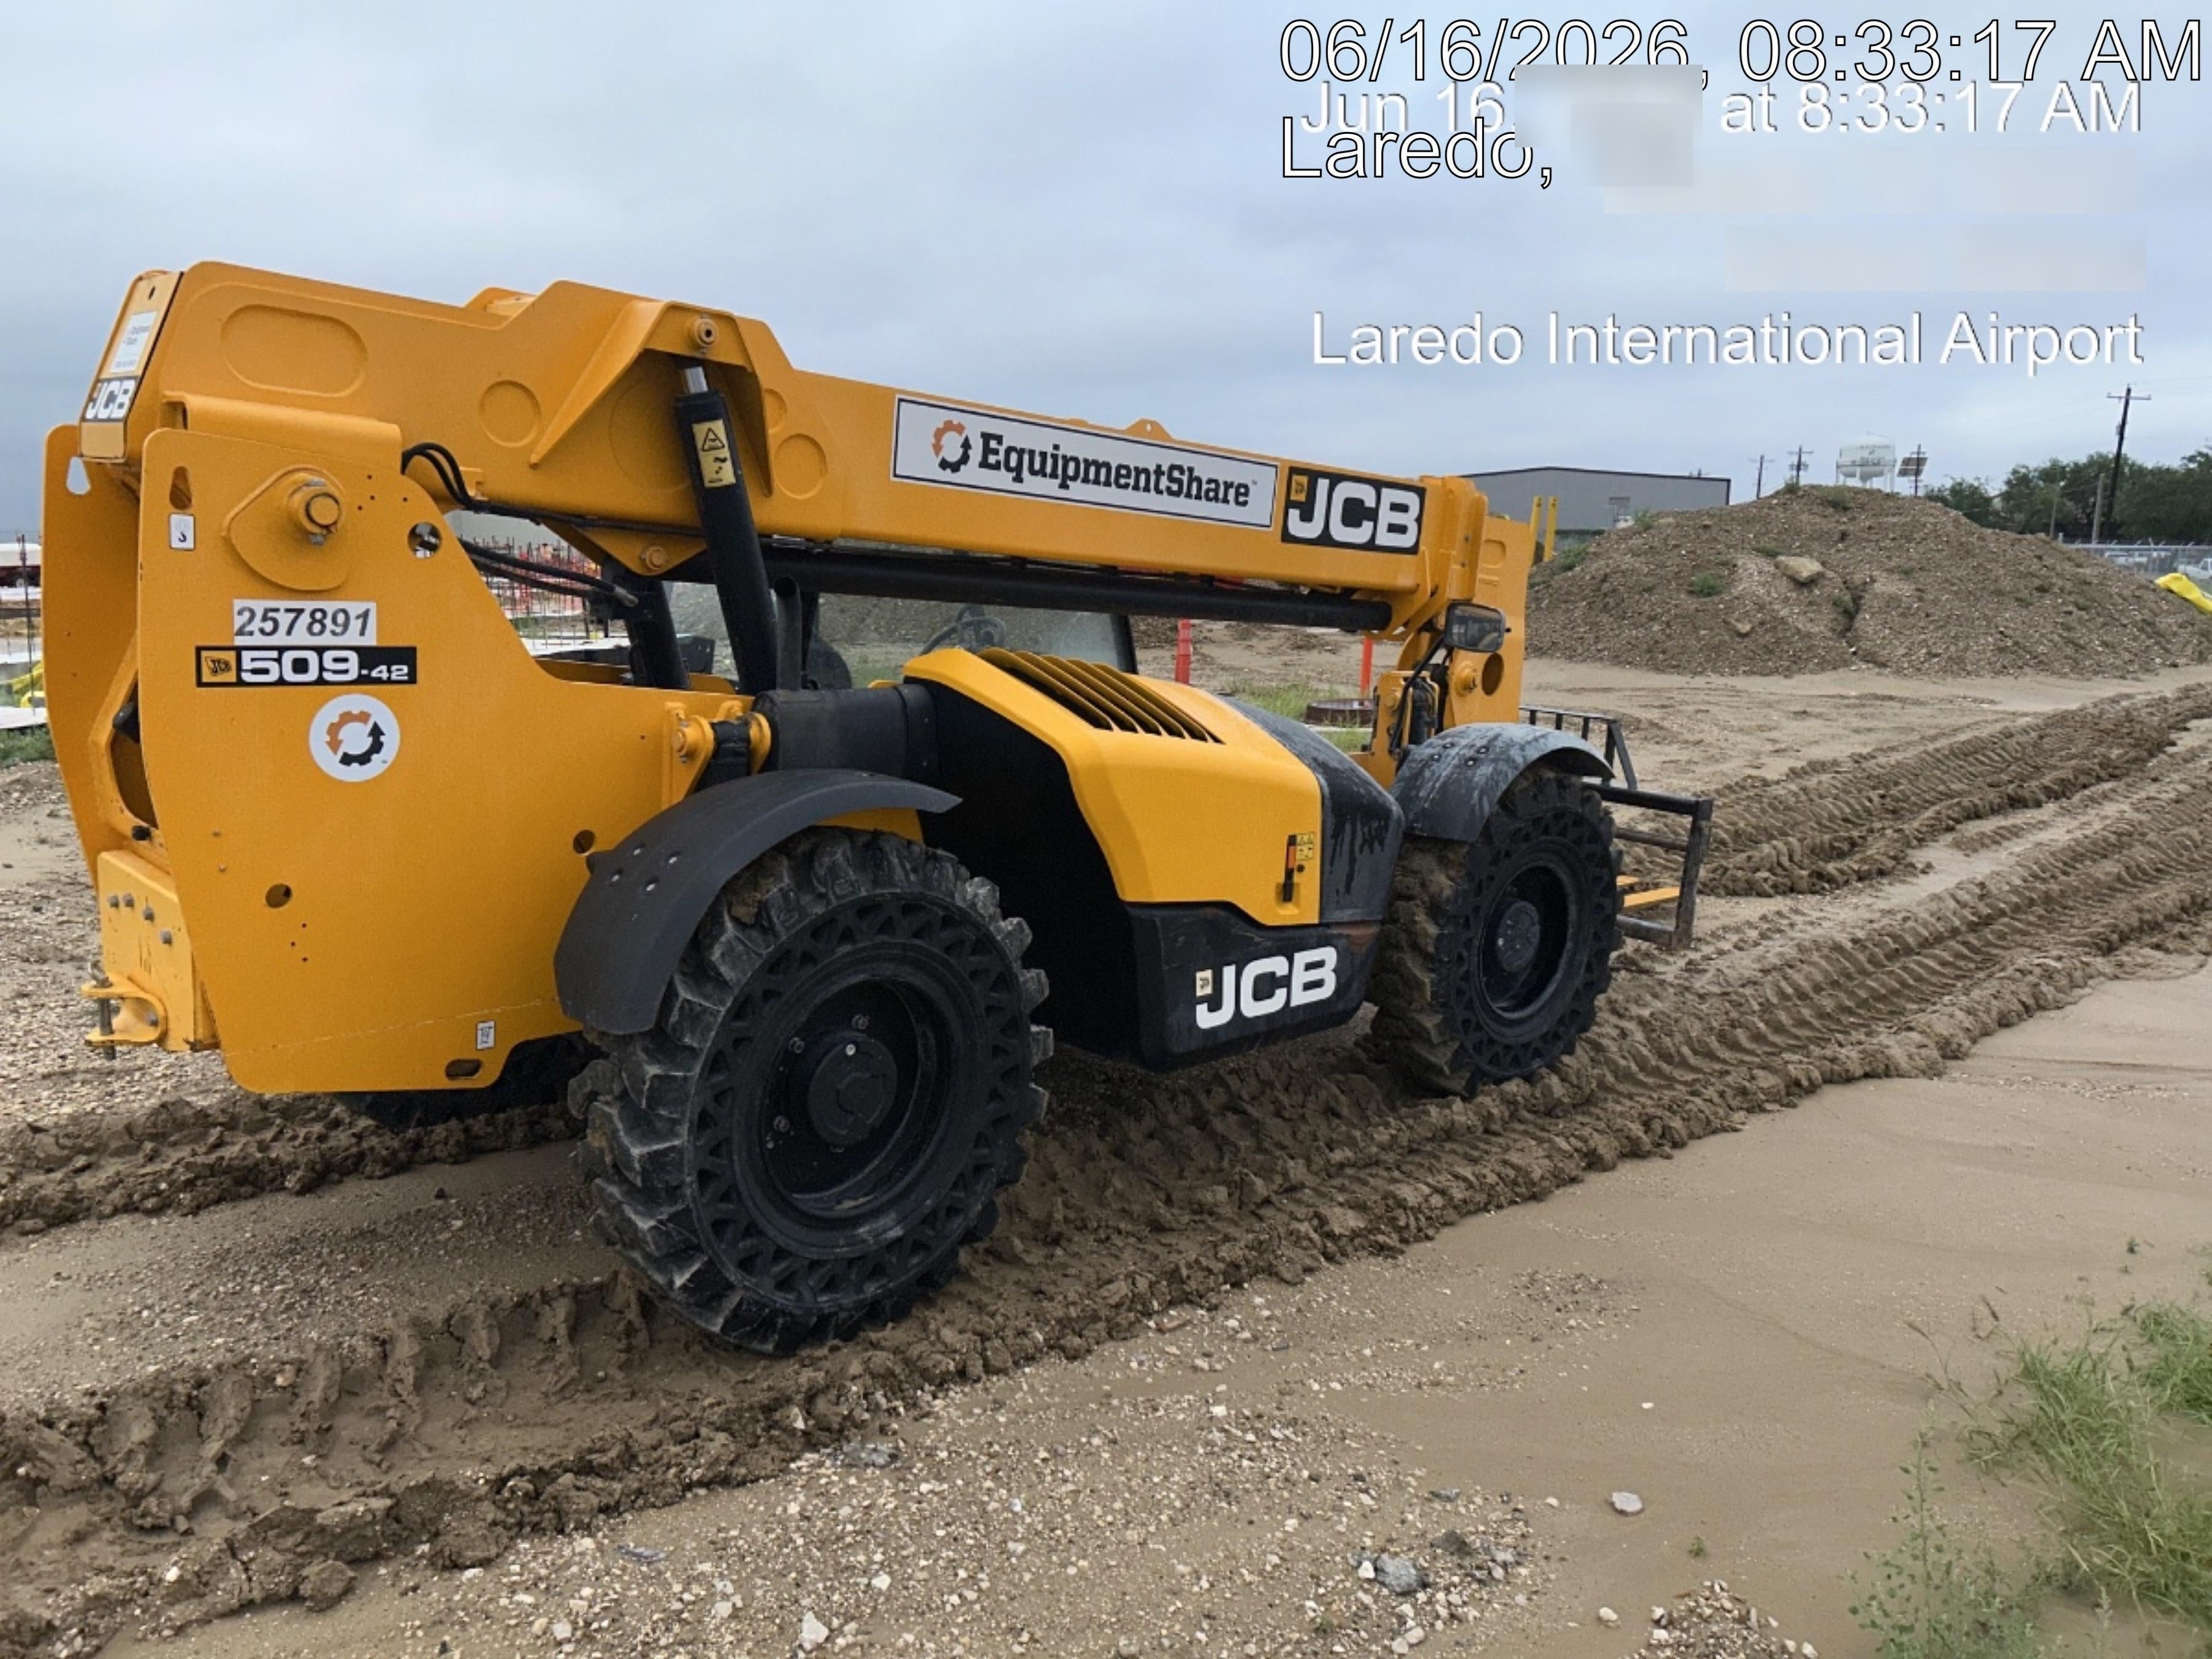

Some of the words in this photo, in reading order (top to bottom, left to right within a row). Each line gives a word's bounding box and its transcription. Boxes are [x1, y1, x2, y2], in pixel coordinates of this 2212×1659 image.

[85, 379, 136, 419] JCB
[978, 431, 1250, 508] EquipmentShare
[1288, 477, 1420, 548] JCB
[235, 606, 372, 638] 257891
[240, 650, 409, 683] 509-42
[1196, 946, 1338, 1030] JCB
